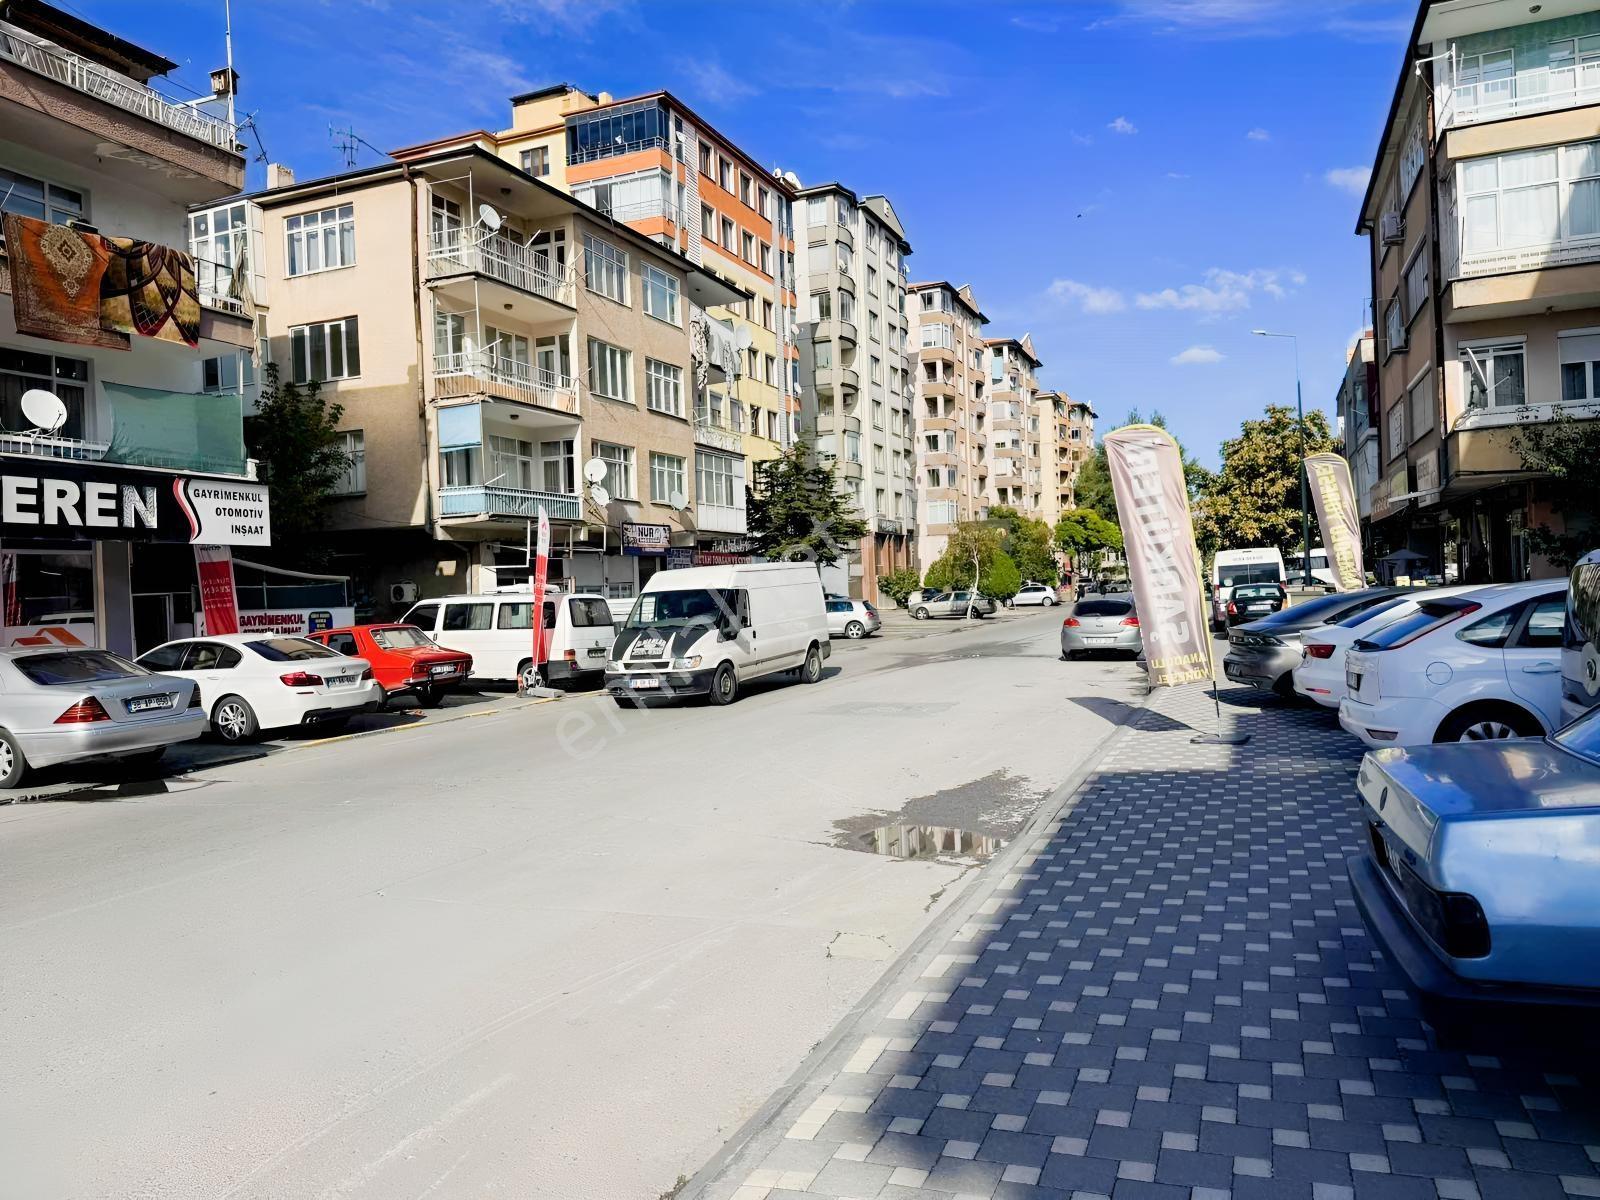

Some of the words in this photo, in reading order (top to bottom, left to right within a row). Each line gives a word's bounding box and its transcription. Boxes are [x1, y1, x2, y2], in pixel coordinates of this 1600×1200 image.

[2, 475, 158, 529] EREN
[193, 488, 263, 502] GAYRİMENKUL
[215, 507, 263, 518] OTOMOTİV
[638, 526, 654, 538] NUR
[239, 613, 306, 627] GAYRİMENKUL
